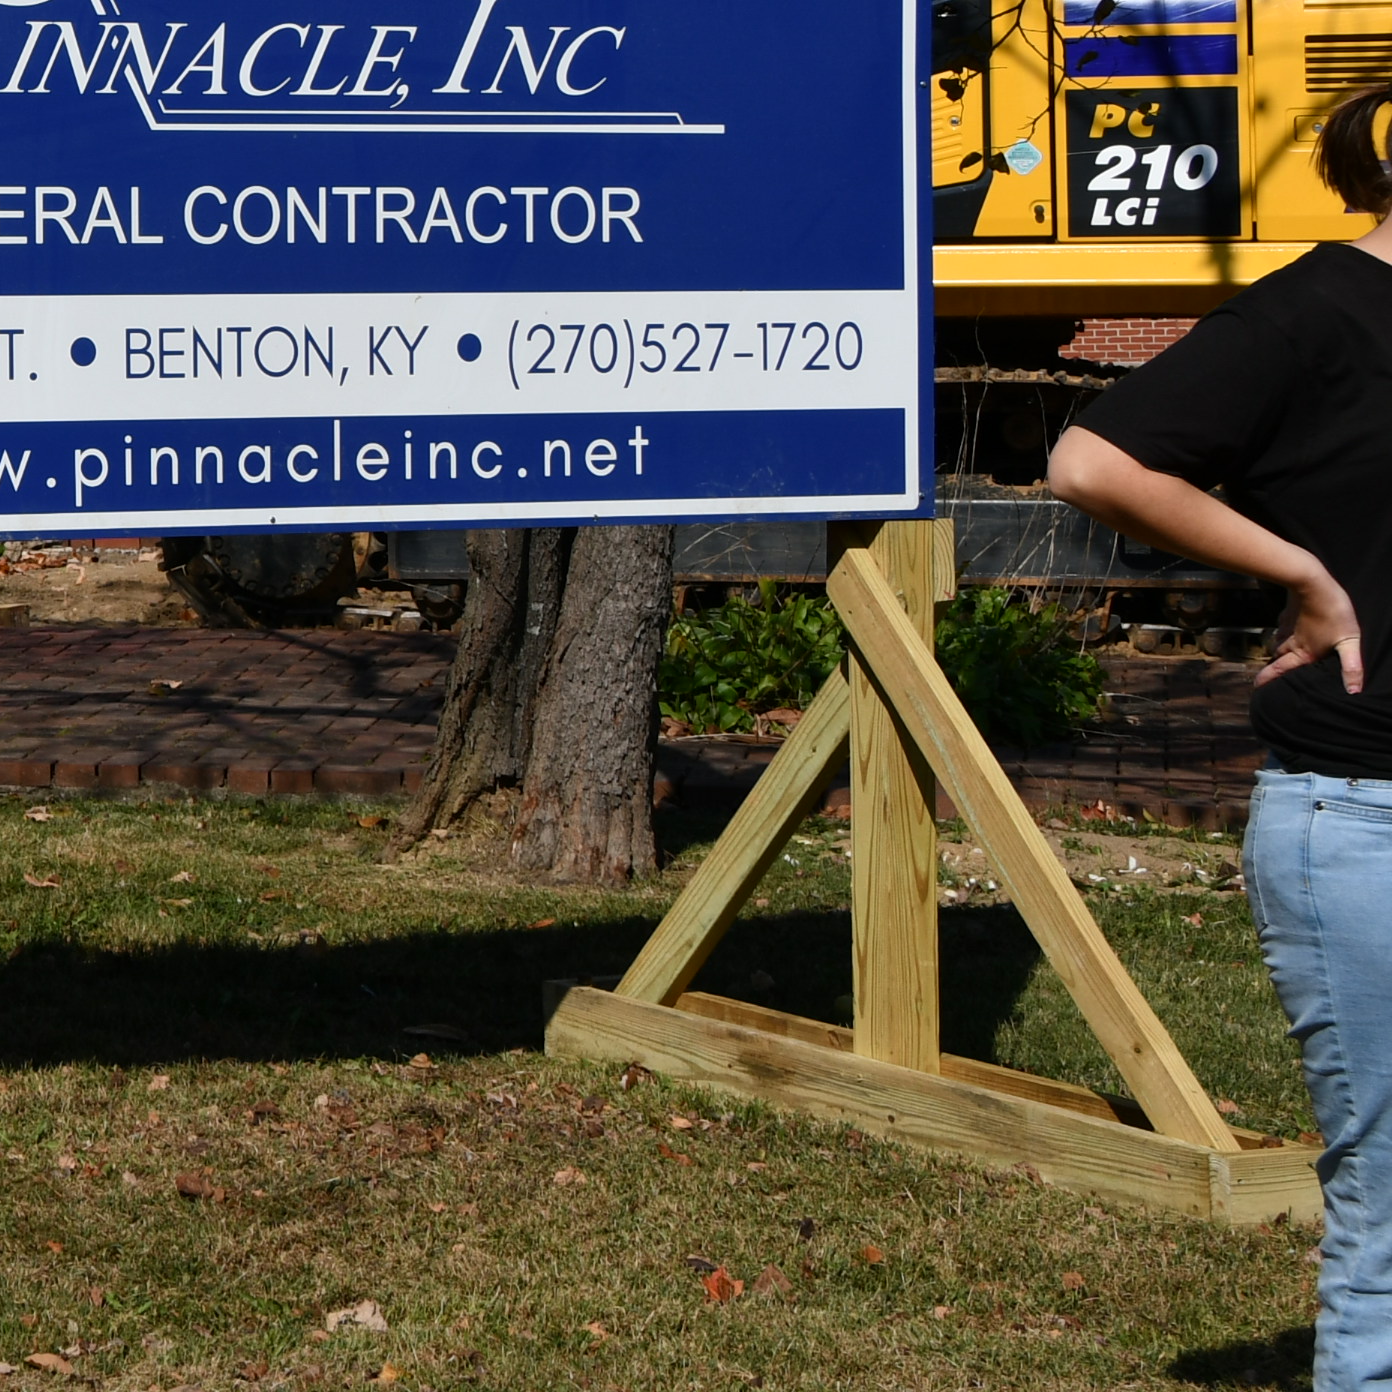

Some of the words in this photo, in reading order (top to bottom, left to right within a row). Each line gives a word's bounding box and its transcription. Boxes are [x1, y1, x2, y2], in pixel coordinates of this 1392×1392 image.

[1089, 103, 1161, 139] PC
[1087, 144, 1218, 191] 210
[183, 184, 644, 245] CONTRACTOR
[1090, 197, 1161, 226] LCi
[124, 325, 349, 387] BENTON,
[368, 324, 429, 376] KY
[508, 318, 863, 389] (270)527-1720
